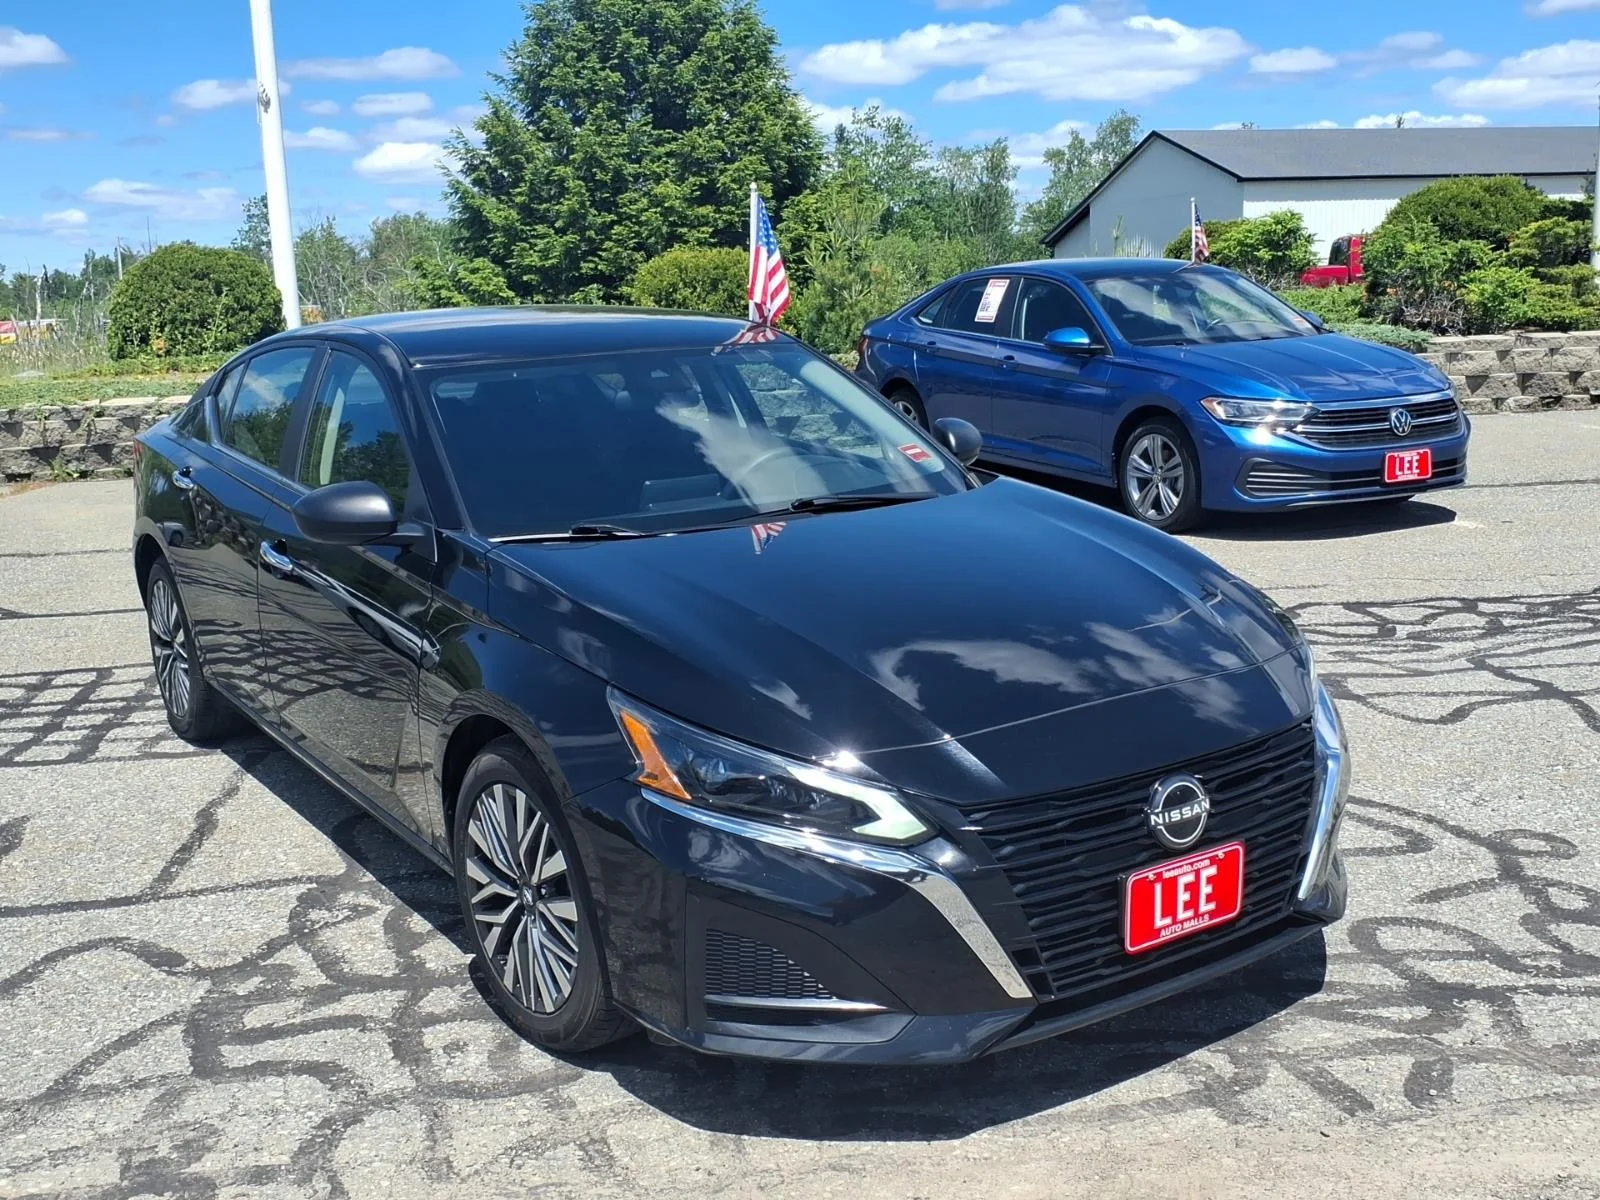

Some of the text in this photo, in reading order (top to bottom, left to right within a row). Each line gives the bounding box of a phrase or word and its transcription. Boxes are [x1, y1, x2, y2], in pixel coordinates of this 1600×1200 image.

[1395, 455, 1420, 476] LEE
[1151, 799, 1210, 826] NISSAN
[1162, 859, 1210, 879] leeauto.com
[1154, 865, 1217, 929] LEE
[1160, 915, 1210, 938] AUTO MALLS
